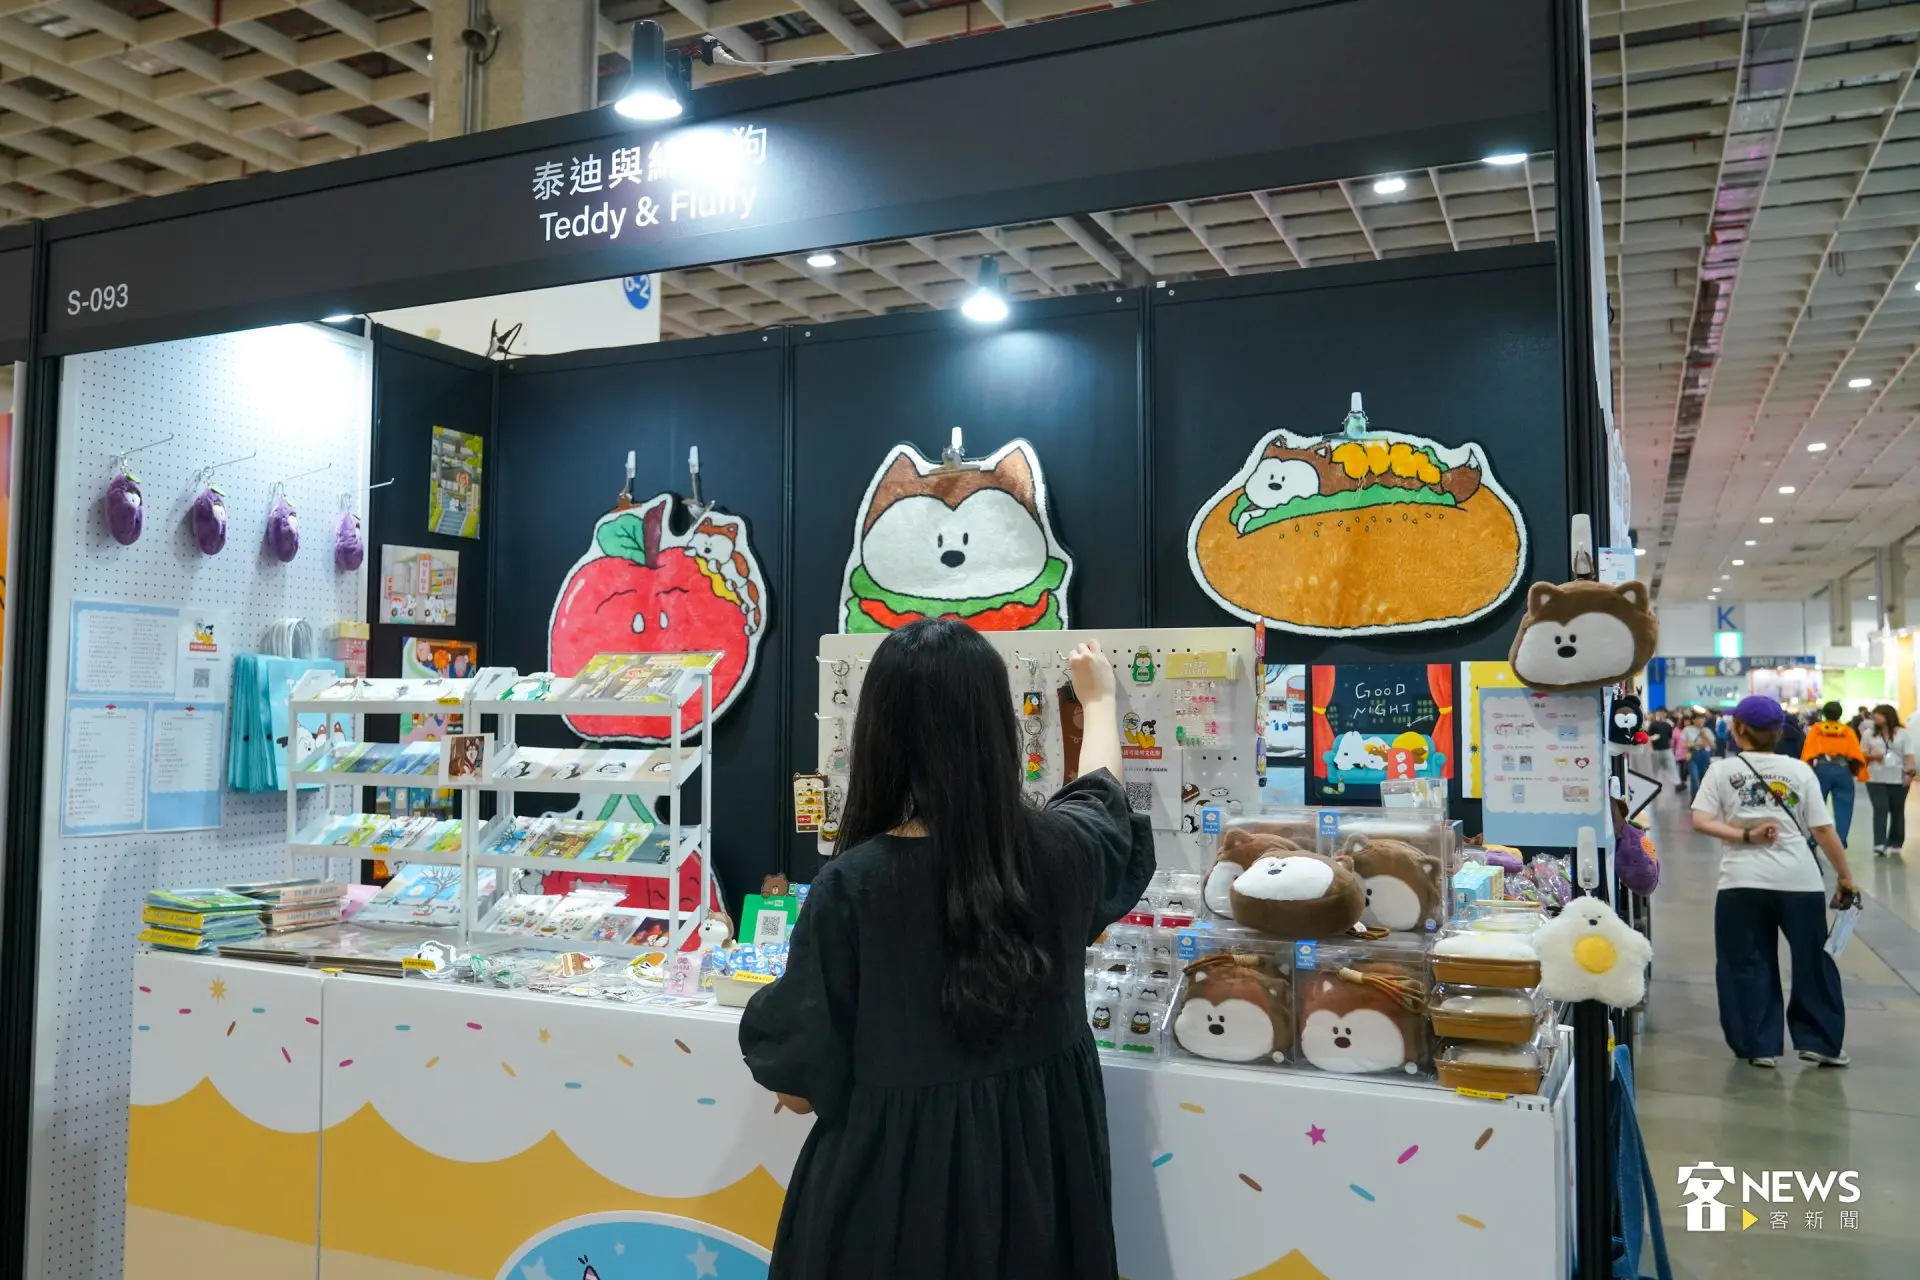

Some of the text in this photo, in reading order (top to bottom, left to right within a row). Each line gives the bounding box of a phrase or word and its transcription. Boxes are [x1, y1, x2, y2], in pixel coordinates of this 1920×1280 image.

[540, 202, 627, 241] Teddy
[635, 196, 659, 227] &
[67, 283, 129, 316] S-093
[1717, 606, 1737, 629] K
[1355, 682, 1406, 700] GOOD
[1353, 703, 1411, 720] NIGHT
